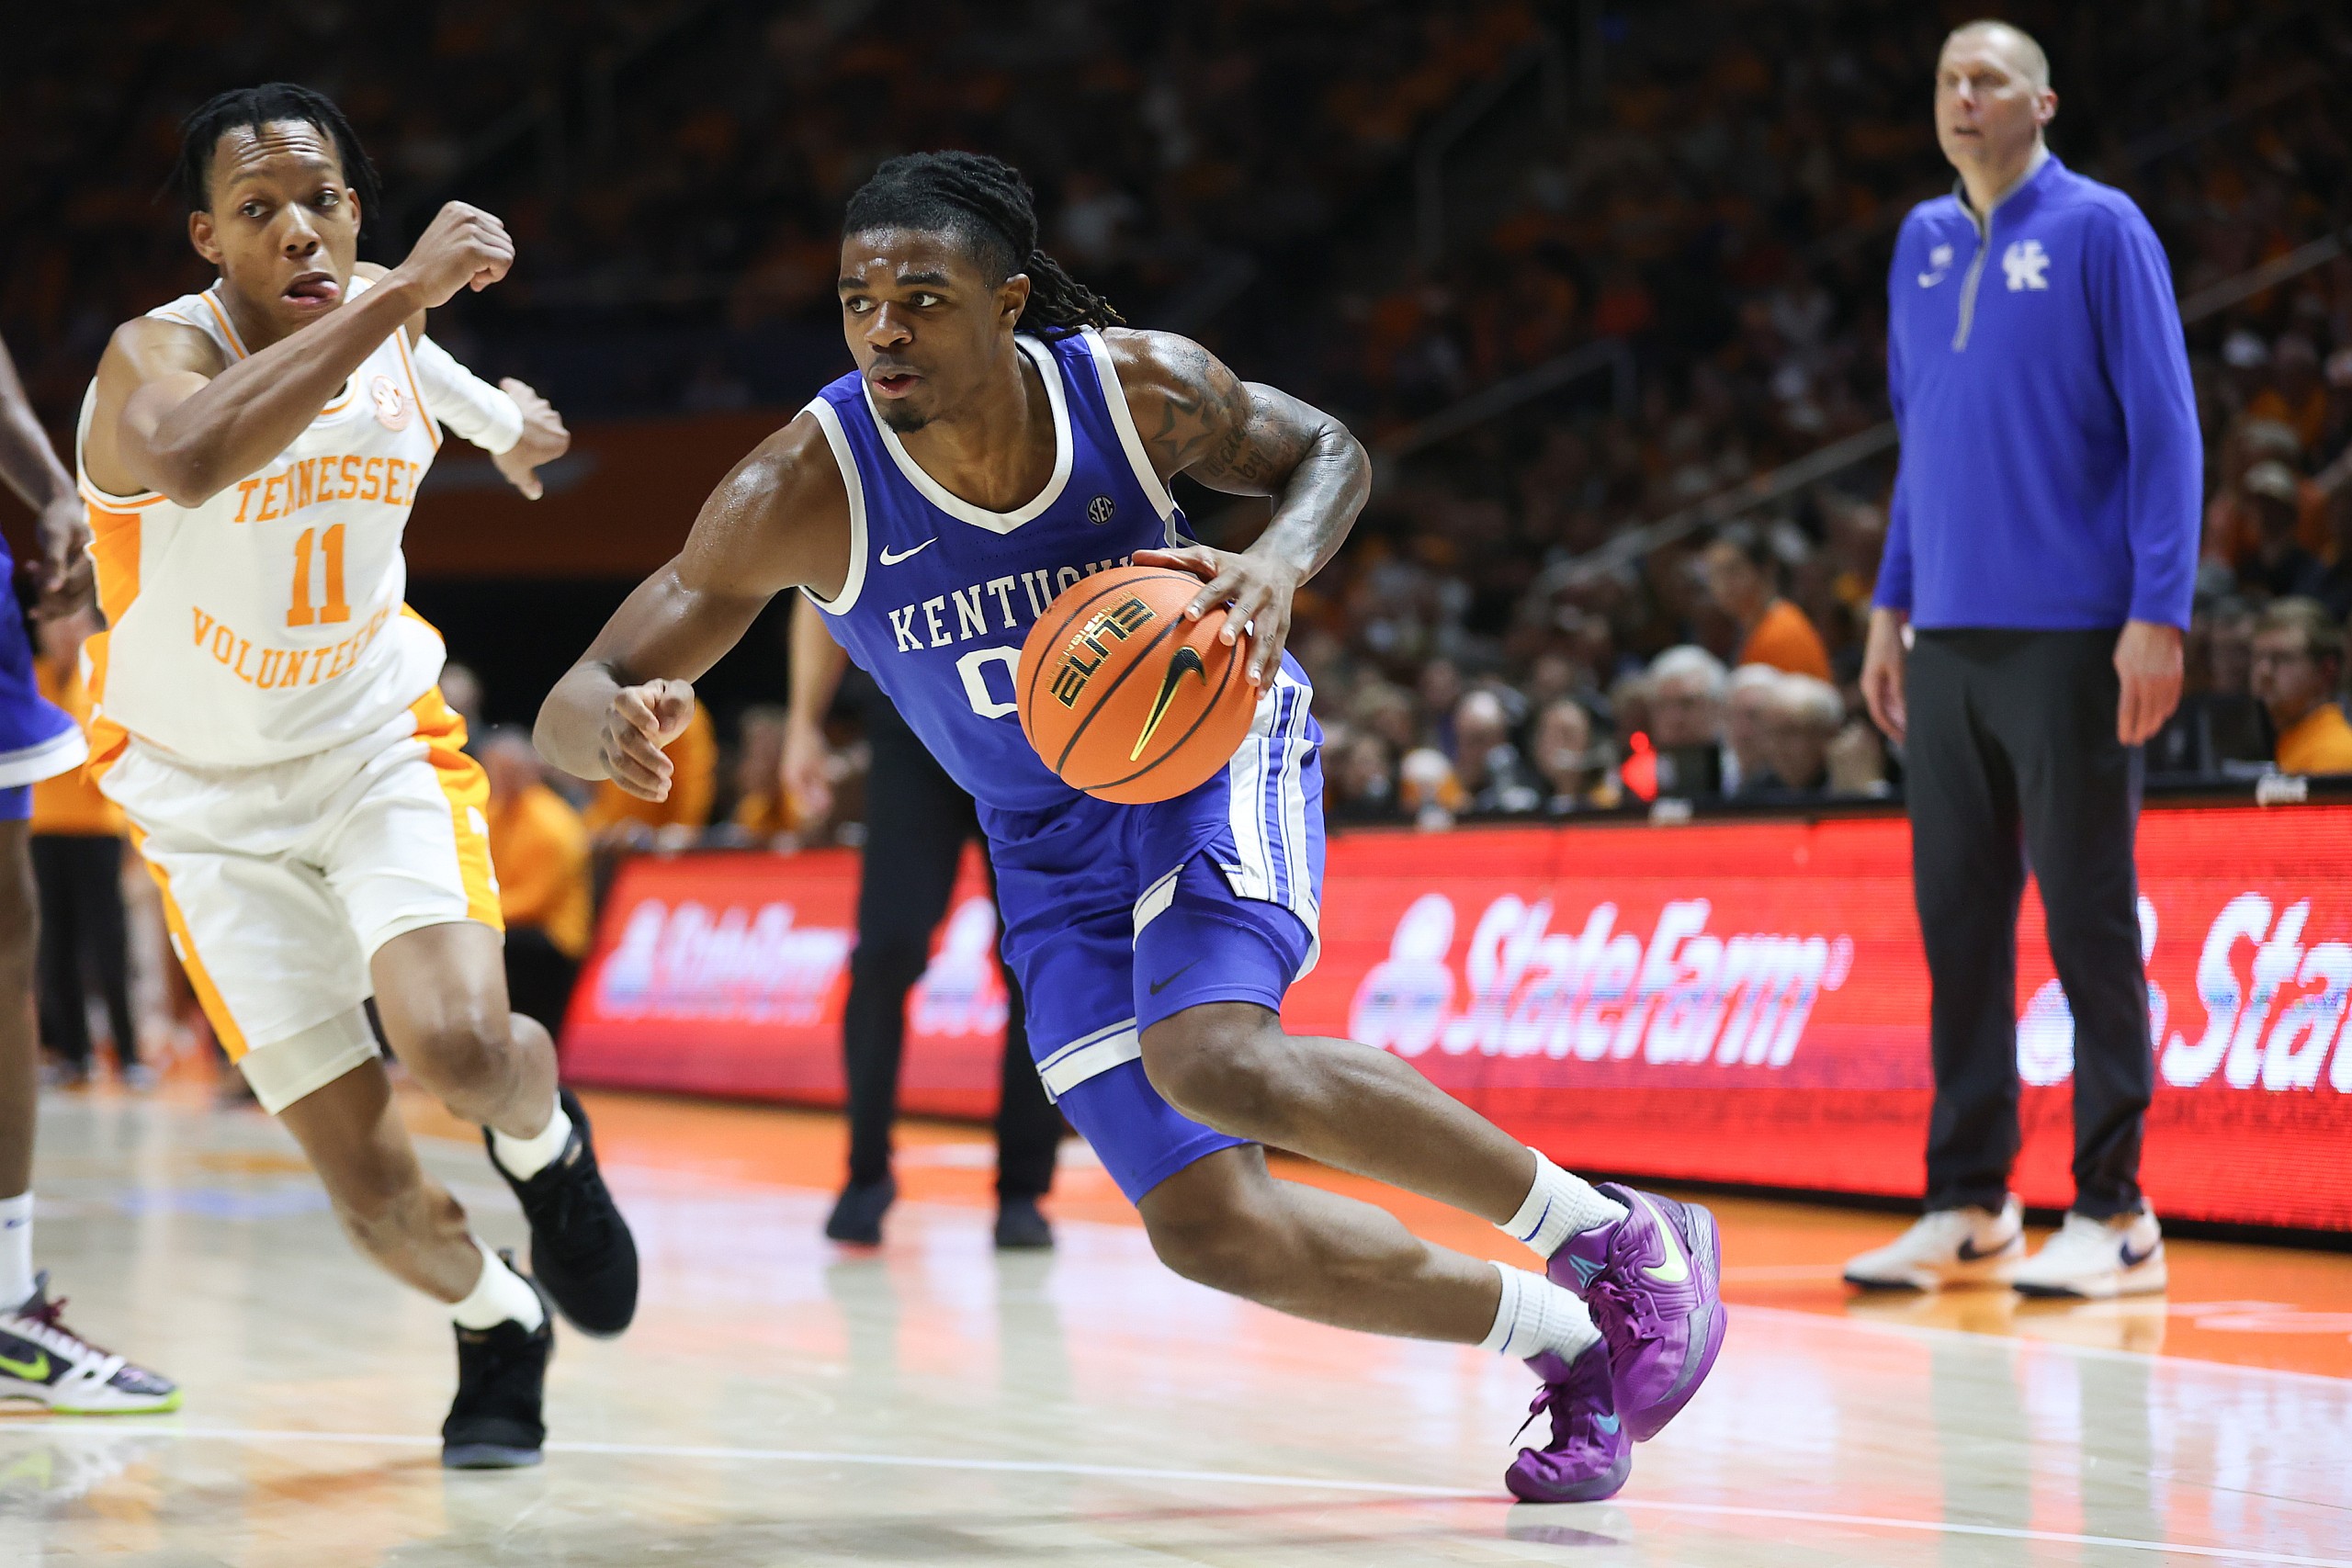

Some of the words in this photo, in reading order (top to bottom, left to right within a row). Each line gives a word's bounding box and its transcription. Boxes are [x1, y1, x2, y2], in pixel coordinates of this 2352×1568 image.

[1089, 496, 1113, 523] SEC
[287, 524, 351, 627] 11
[1049, 597, 1157, 710] ELITE
